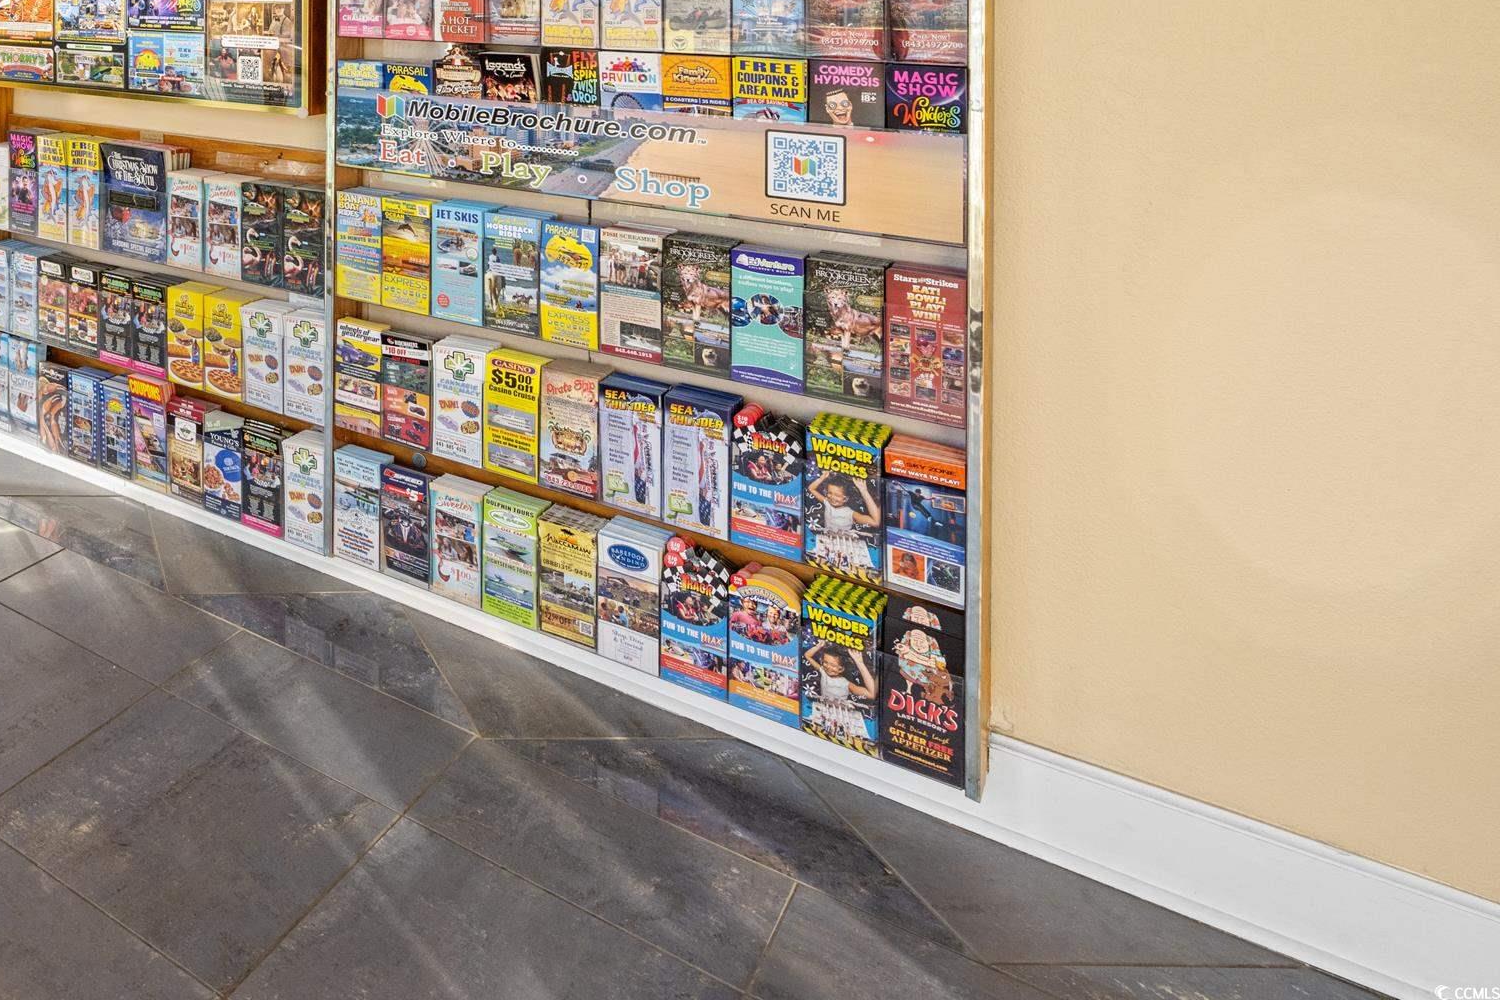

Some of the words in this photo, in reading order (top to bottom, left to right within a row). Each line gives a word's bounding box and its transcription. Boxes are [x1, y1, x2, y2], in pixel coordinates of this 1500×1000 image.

[440, 25, 478, 34] TICKET!
[572, 51, 596, 62] FLY
[386, 64, 428, 77] PARASAIL
[573, 61, 597, 70] FLIP
[678, 65, 710, 77] Family
[739, 60, 797, 74] FREE
[819, 65, 874, 77] COMEDY
[573, 70, 597, 81] SPIN
[601, 72, 657, 84] PAVILION
[672, 73, 717, 85] Kingdom
[814, 75, 880, 88] HYPNOSIS
[894, 70, 959, 85] MAGIC
[573, 79, 597, 94] TWIST
[739, 85, 768, 96] AREA
[771, 87, 799, 98] MAP
[897, 83, 957, 97] SHOW
[407, 100, 698, 143] MobileBrochure.com
[10, 133, 32, 144] MAGIC
[12, 141, 34, 150] SHOW
[107, 155, 138, 172] CHRISTMAS
[139, 160, 158, 175] SHOW
[115, 171, 122, 181] OF
[379, 140, 426, 166] Eat
[481, 151, 552, 188] Play
[615, 167, 711, 208] Shop
[339, 193, 377, 207] BANANA
[339, 201, 360, 211] BOAT
[436, 209, 452, 220] JET
[454, 211, 479, 223] SKIS
[770, 203, 812, 218] SCAN
[817, 208, 841, 223] ME
[486, 223, 534, 235] HORSEBACK
[499, 230, 522, 239] RIDES
[545, 224, 579, 238] PARASAIL
[619, 233, 657, 243] SCREAMER
[747, 256, 795, 271] EdVenture
[384, 275, 428, 291] EXPRESS
[911, 285, 941, 296] EAT!
[906, 293, 947, 305] BOWL!
[910, 301, 945, 312] PLAY!
[547, 312, 591, 325] EXPRESS
[911, 310, 941, 321] WIN!
[494, 359, 532, 373] CASINO
[129, 377, 160, 401] COUPONS
[488, 385, 512, 396] Casino
[513, 390, 536, 402] Cruise
[546, 383, 572, 394] Pirate
[574, 379, 595, 397] Ship
[605, 389, 628, 400] SEA
[605, 399, 656, 413] THUNDER
[670, 403, 693, 415] SEA
[670, 415, 724, 429] THUNDER
[210, 432, 240, 446] YOUNG'S
[811, 436, 873, 464] WONDER
[815, 453, 868, 480] WORKS
[905, 462, 926, 471] SKY
[928, 465, 957, 477] ZONE
[891, 467, 906, 475] NEW
[907, 470, 928, 479] WAYS
[939, 476, 960, 486] PLAY!
[436, 501, 473, 512] Sweeter
[486, 498, 512, 512] DOLPHIN
[513, 507, 535, 518] TOURS
[611, 547, 646, 562] BAREFOOT
[806, 605, 869, 636] WONDER
[810, 622, 865, 651] WORKS
[888, 688, 959, 731] DICK'S
[897, 712, 914, 721] LAST
[920, 718, 948, 733] RESORT
[889, 726, 906, 738] GIT
[906, 730, 927, 744] YER
[927, 740, 954, 756] FREE
[891, 736, 952, 762] APPETIZER
